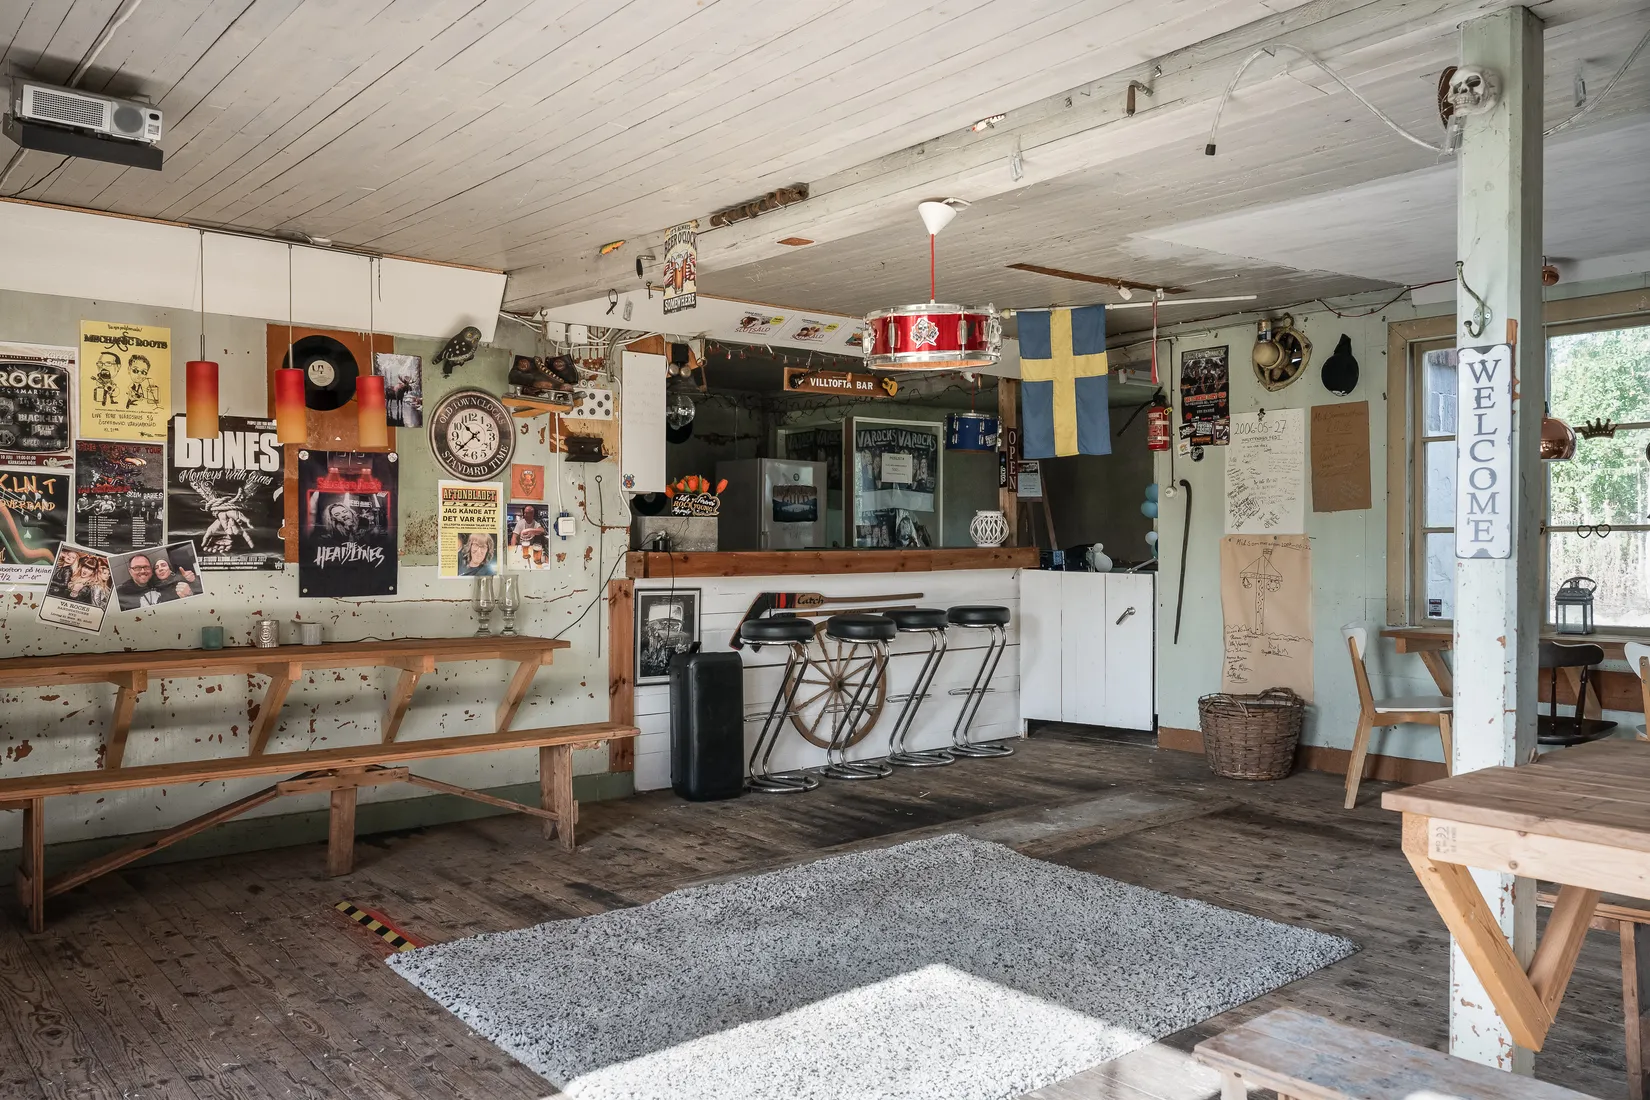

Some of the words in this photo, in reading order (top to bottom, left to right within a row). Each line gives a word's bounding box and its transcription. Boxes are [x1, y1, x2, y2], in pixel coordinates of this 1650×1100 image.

[665, 293, 695, 310] SOMEWHERE
[136, 337, 167, 349] ROOTS
[0, 371, 60, 390] ROCK
[810, 377, 852, 389] VILLTOFTA
[856, 381, 873, 390] BAR
[440, 406, 453, 425] OLD
[468, 413, 478, 422] 12
[453, 422, 462, 431] 10
[486, 423, 493, 432] 2
[451, 431, 459, 442] 9
[489, 432, 496, 442] 3
[174, 416, 280, 472] BONES
[145, 447, 162, 455] TOUR
[471, 451, 478, 460] 6
[480, 449, 487, 458] 5
[1465, 358, 1502, 543] WELCOME
[442, 450, 488, 476] STANDARD
[489, 444, 508, 469] TIME
[1008, 430, 1017, 490] OPEN
[179, 467, 222, 483] Monkeys
[225, 468, 246, 481] With
[246, 474, 273, 486] Guns
[443, 489, 497, 501] AFTONBLADET
[694, 503, 713, 512] YOUNG
[313, 545, 385, 569] HEADLINES
[797, 594, 824, 605] Catch
[70, 604, 90, 612] ROCKS
